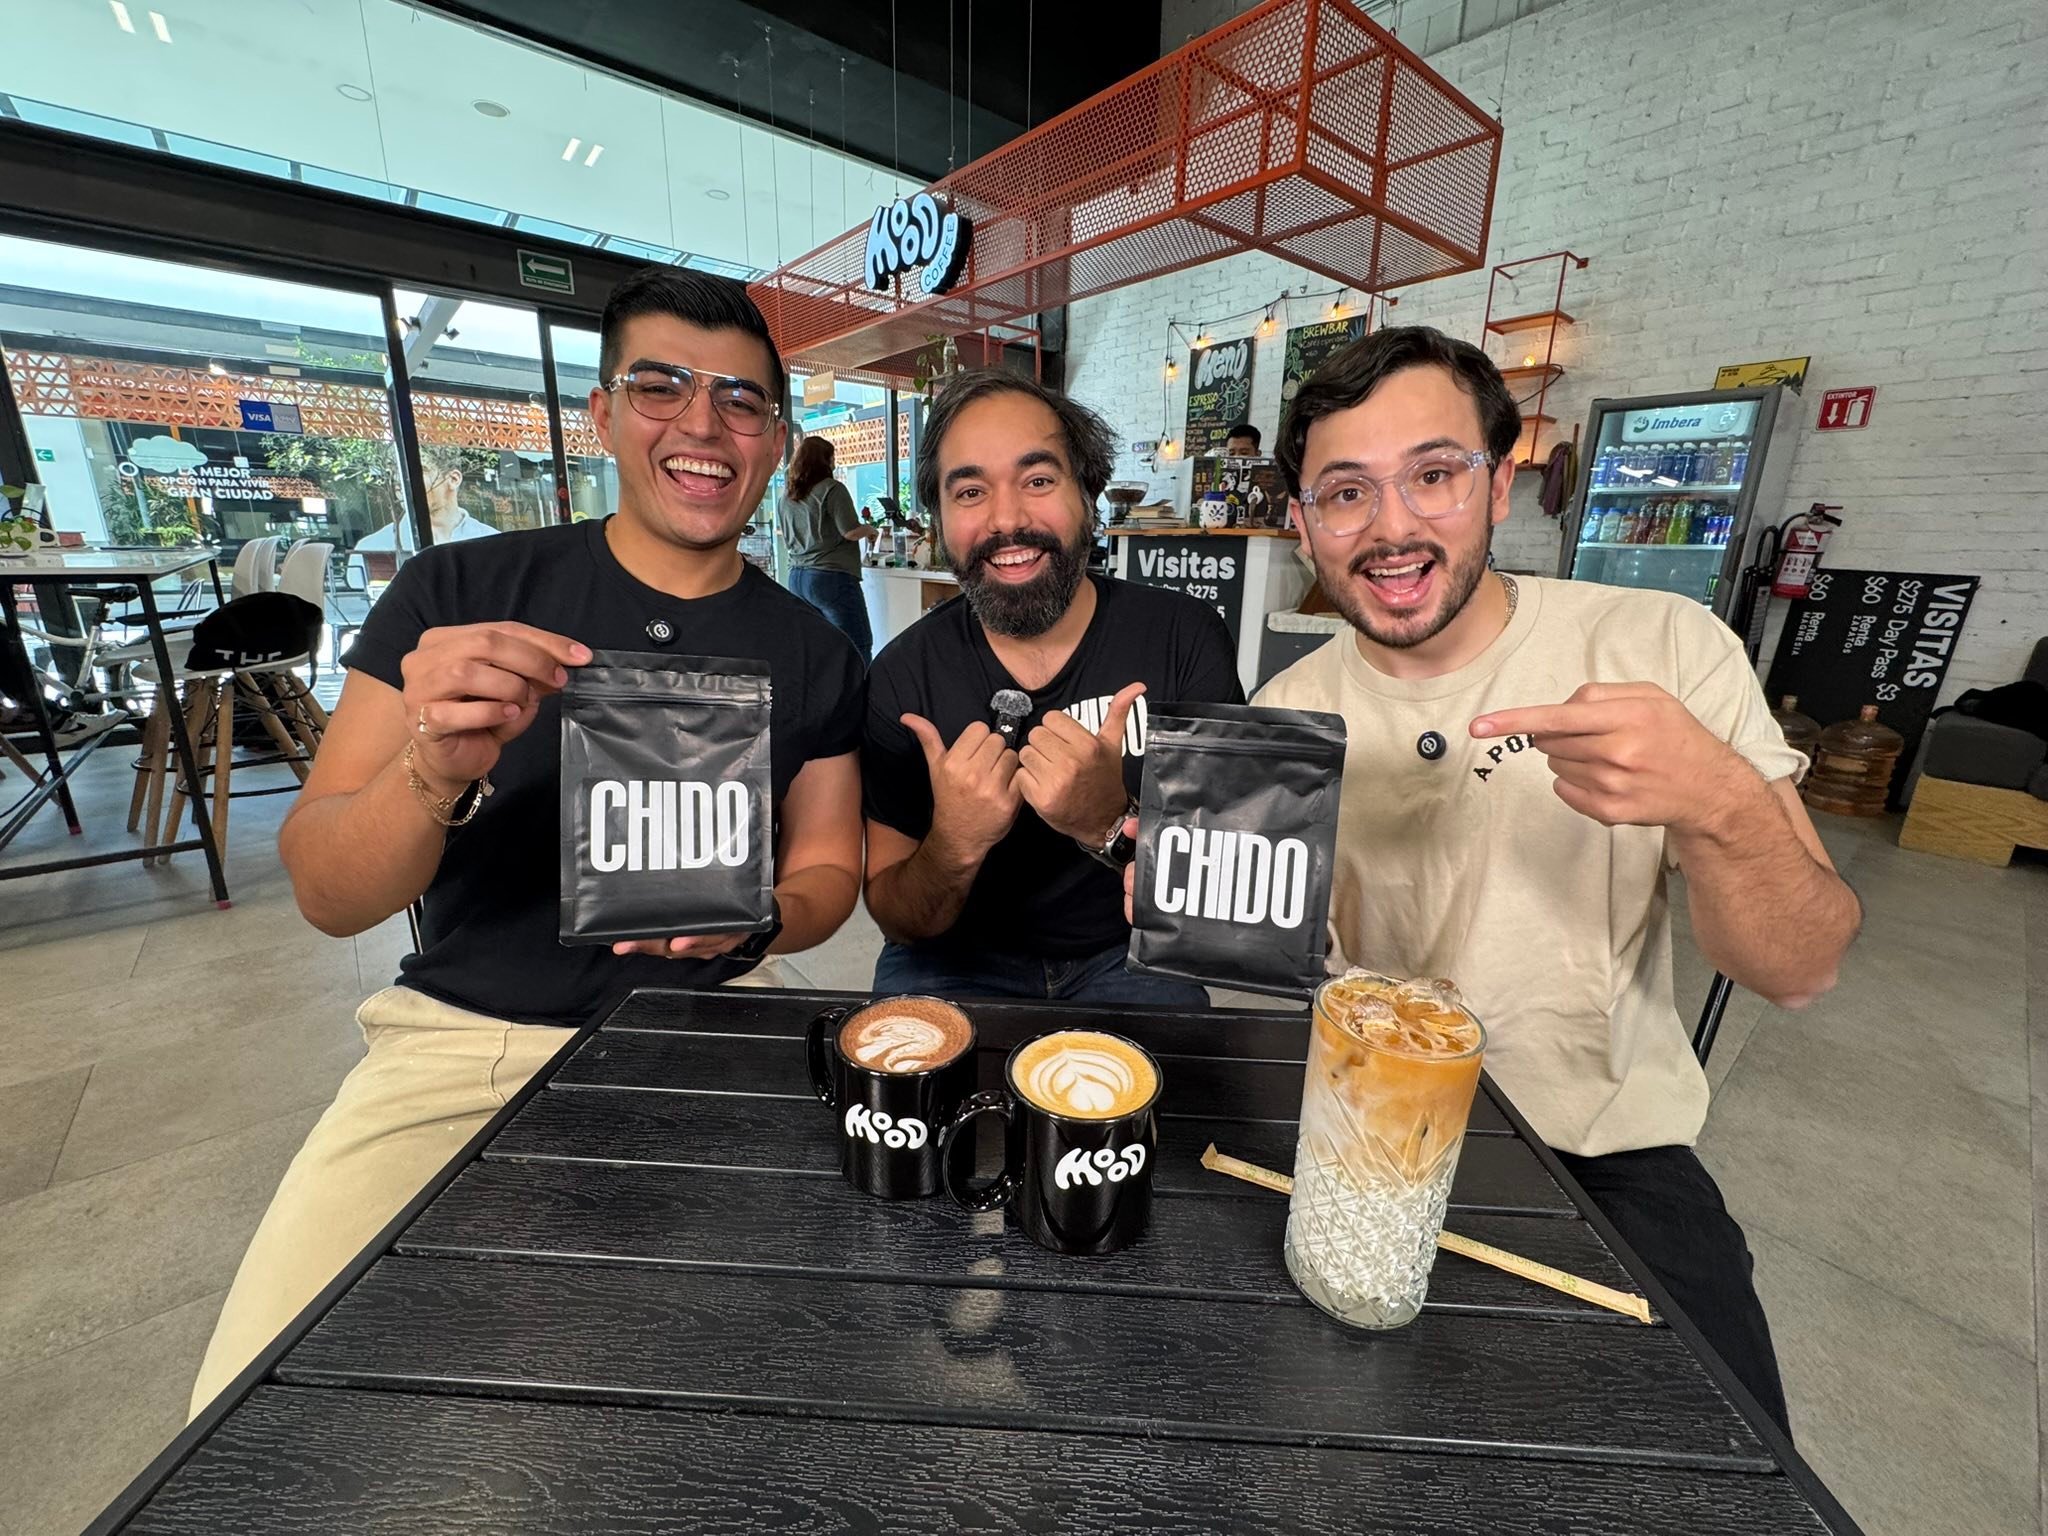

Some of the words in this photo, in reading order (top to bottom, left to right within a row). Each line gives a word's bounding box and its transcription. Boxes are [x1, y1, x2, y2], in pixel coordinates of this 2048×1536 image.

[865, 192, 939, 290] MOOD
[924, 221, 955, 287] COFFEE
[1827, 391, 1857, 400] EXTINTOR
[247, 412, 272, 423] VISA
[1651, 417, 1702, 430] Imbera
[159, 475, 207, 487] OPCIÓN
[208, 479, 239, 488] PARA
[239, 480, 271, 488] VIVIR
[178, 467, 198, 476] LA
[200, 467, 250, 479] MEJOR
[167, 487, 212, 498] GRAN
[215, 489, 274, 500] CIUDAD
[1138, 548, 1236, 580] Visitas
[1186, 582, 1218, 600] $275
[1808, 574, 1834, 601] $60
[1862, 576, 1889, 604] $60
[1893, 580, 1924, 615] $275
[1791, 611, 1808, 656] MAGNESIA
[1804, 612, 1826, 642] Renta
[1842, 615, 1859, 655] ZAPATOS
[1854, 615, 1878, 648] Renta
[1878, 619, 1909, 648] Day
[1902, 582, 1972, 689] VISITAS
[1871, 648, 1899, 680] Pass
[591, 780, 749, 872] CHIDO
[1154, 826, 1309, 929] CHIDO
[845, 1103, 928, 1150] MOOD
[1054, 1143, 1146, 1190] MOOD
